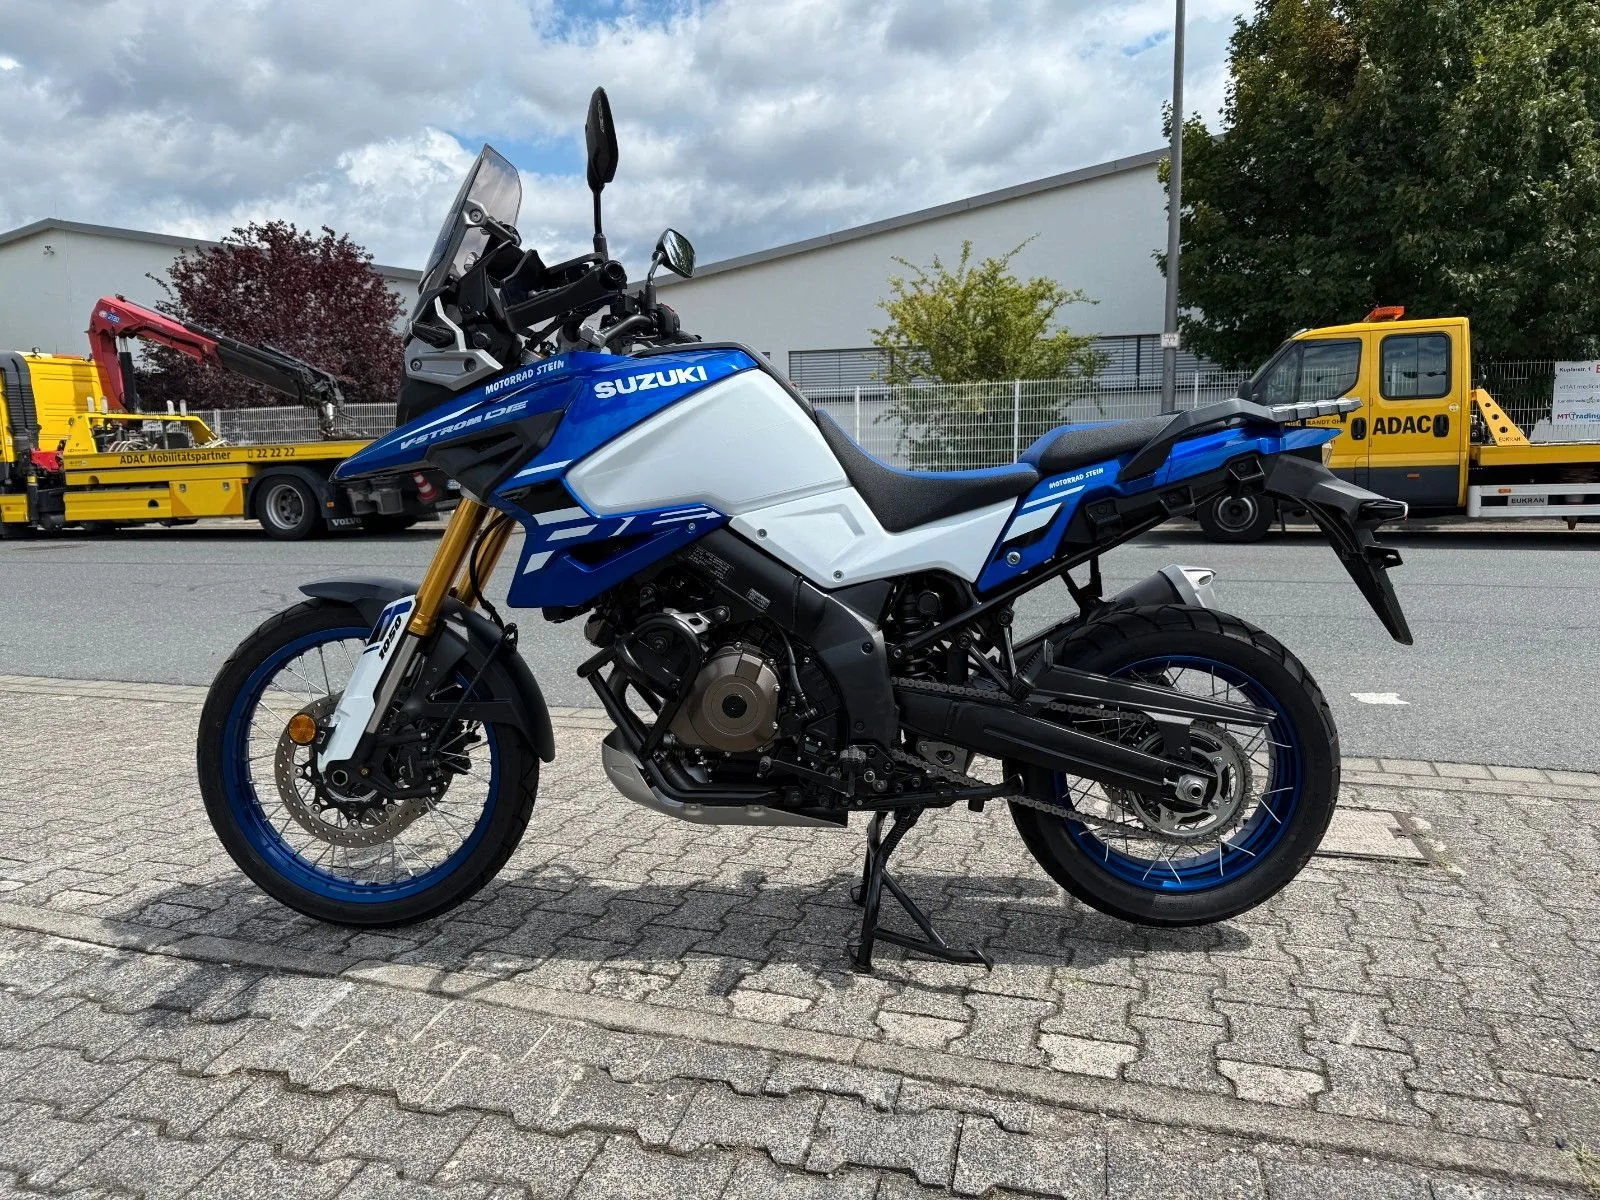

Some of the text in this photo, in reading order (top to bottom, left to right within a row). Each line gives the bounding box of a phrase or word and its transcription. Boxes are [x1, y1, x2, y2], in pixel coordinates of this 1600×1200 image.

[485, 359, 565, 396] MOTORRAD STEIN
[593, 365, 708, 399] SUZUKI
[400, 399, 529, 450] V-STROM DE
[1372, 415, 1432, 436] ADAC
[120, 446, 295, 465] ADAC Mobilitätspartner 22 22 22
[1048, 467, 1104, 490] MOTORRAD STEIN
[1511, 496, 1545, 504] EUKRAN
[332, 518, 362, 527] VOLVO
[379, 615, 402, 661] 1050
